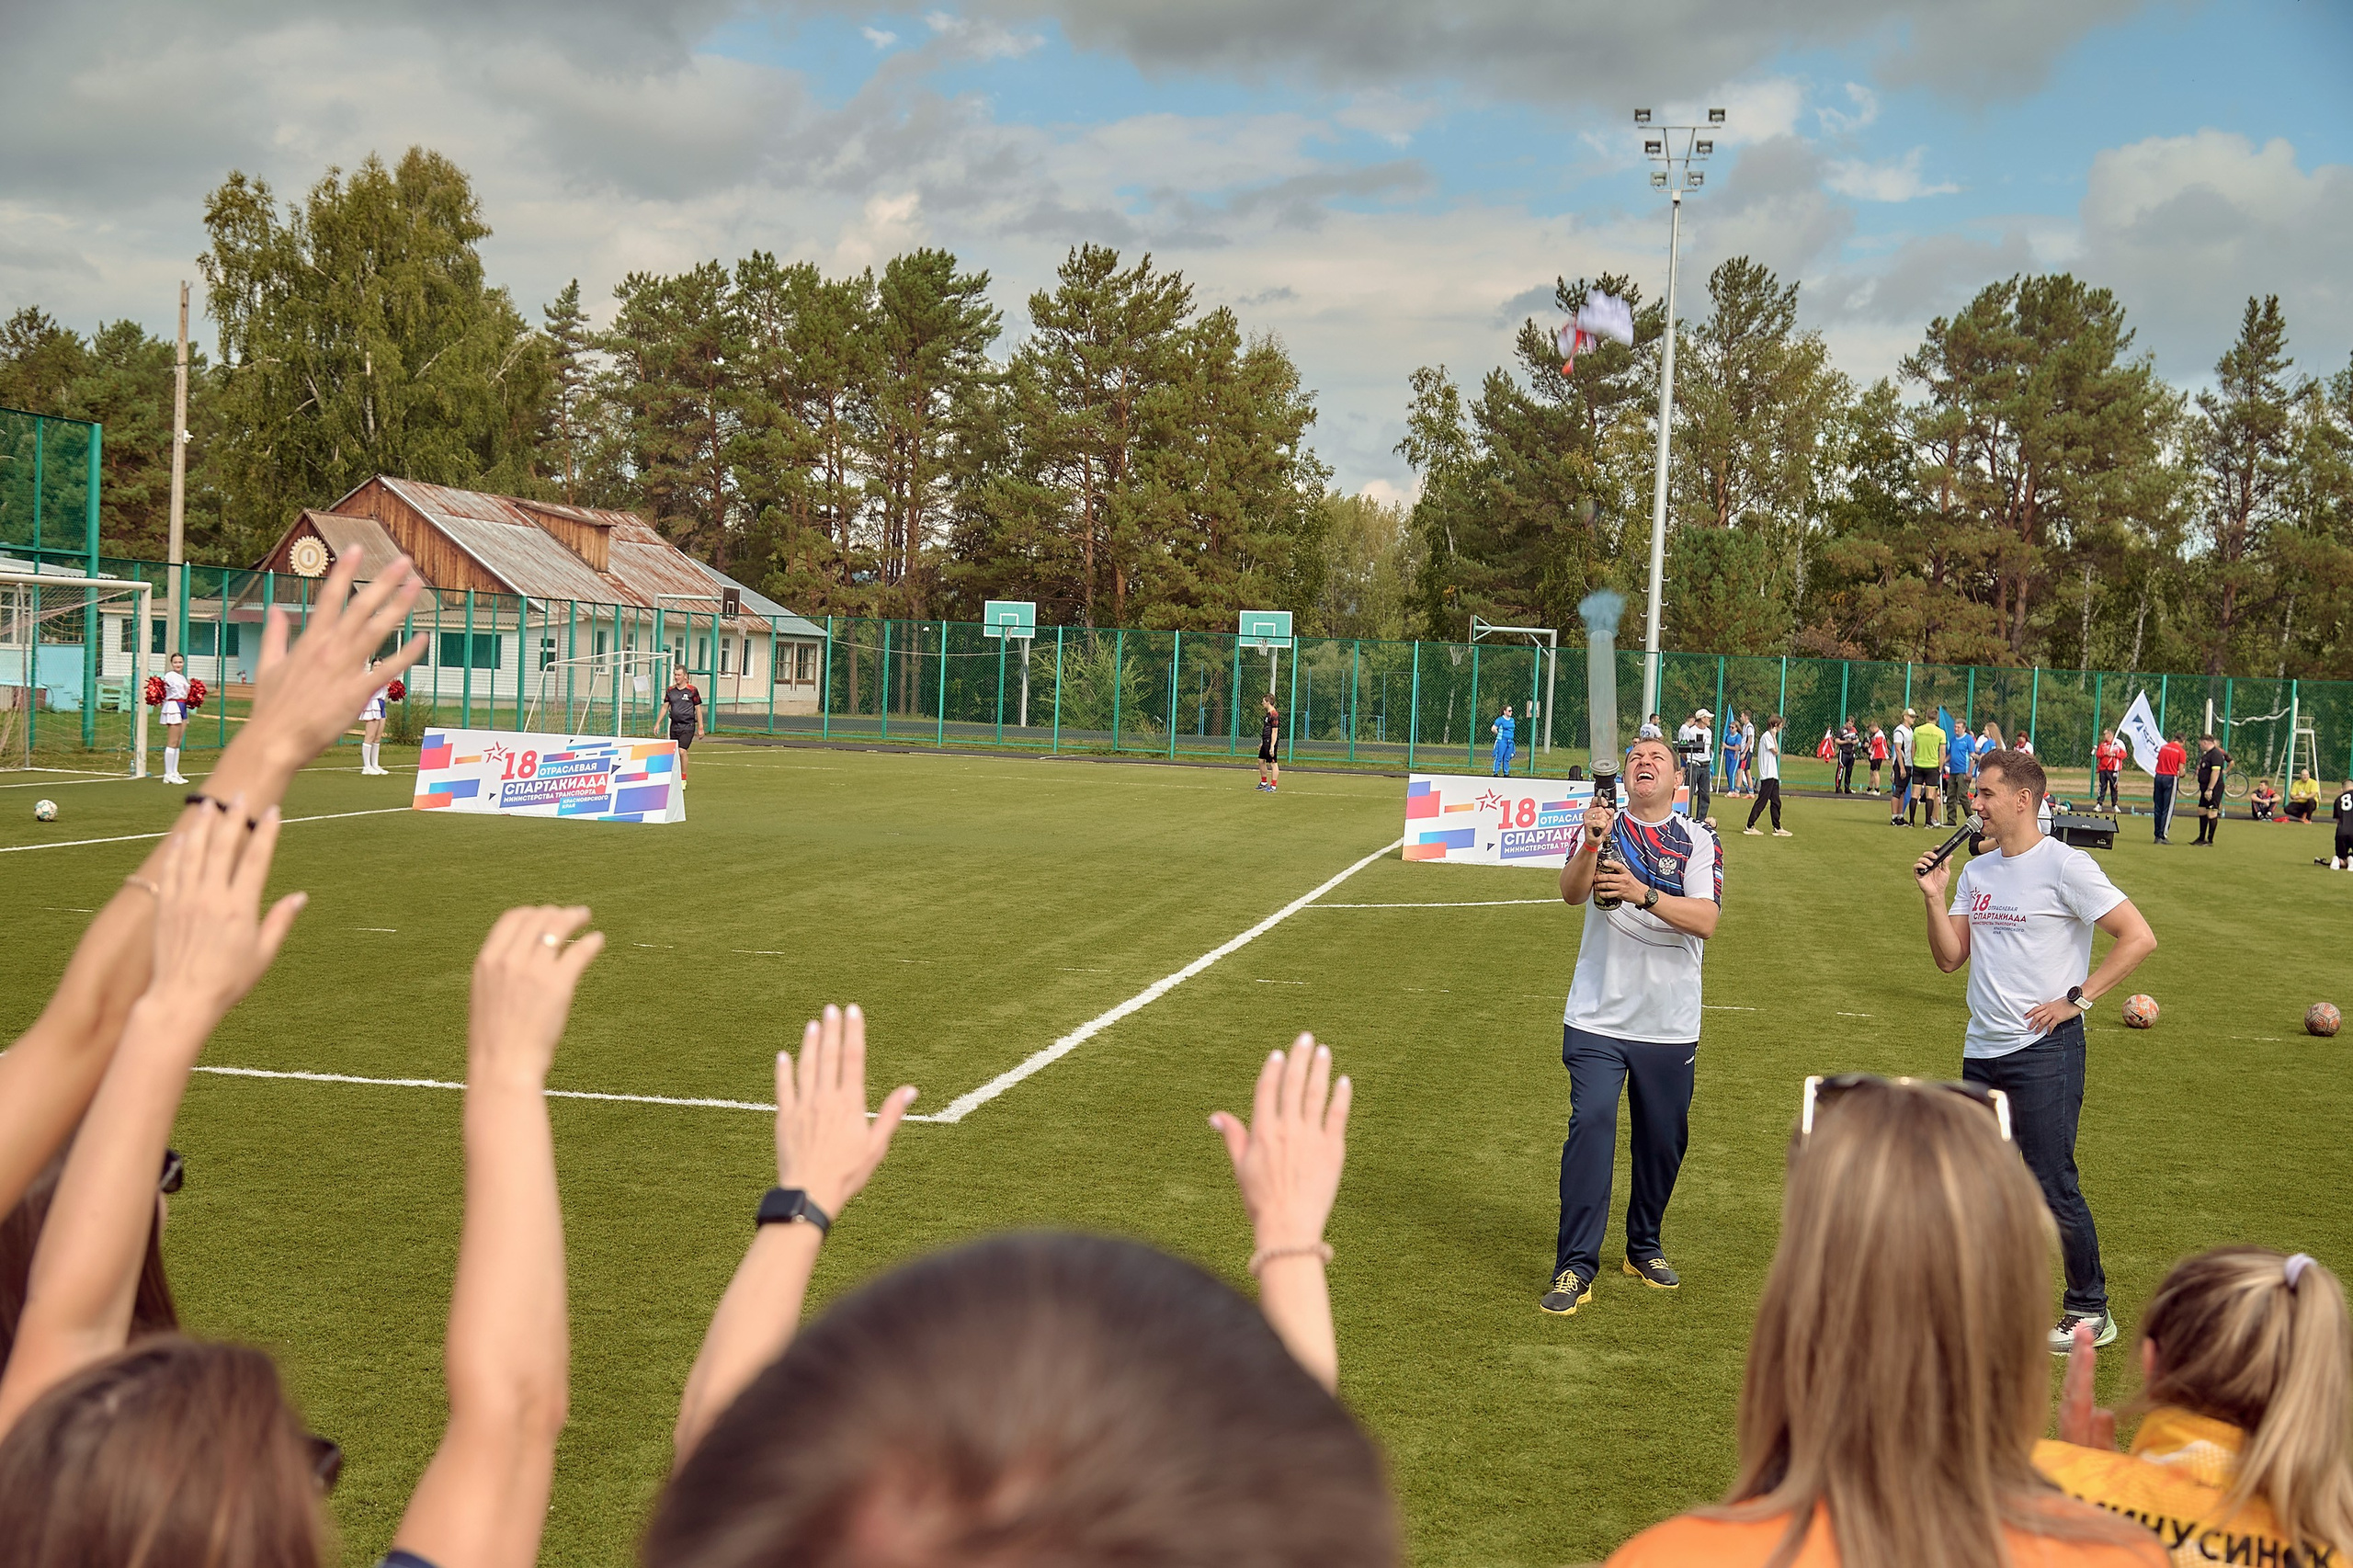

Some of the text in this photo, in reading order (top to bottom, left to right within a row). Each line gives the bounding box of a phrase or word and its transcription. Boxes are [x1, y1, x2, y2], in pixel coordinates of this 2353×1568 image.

[501, 750, 597, 780] 18 ОТРАСЛЕВАЯ
[505, 774, 607, 795] СПАРТАКИАДА
[503, 789, 597, 803] МИНИСТЕРСТВА ТРАНСПОРТА
[563, 794, 609, 804] КРАСНОЯРСКОГО
[2340, 793, 2353, 811] 8
[1497, 798, 1584, 830] 18 ОТРАСЛЕ
[1504, 843, 1559, 854] МИНИСТЕРСТВА
[1972, 893, 1992, 912] 18
[1973, 913, 2027, 923] СПАРТАКИАДА
[2075, 1494, 2336, 1568] НУСИНК
